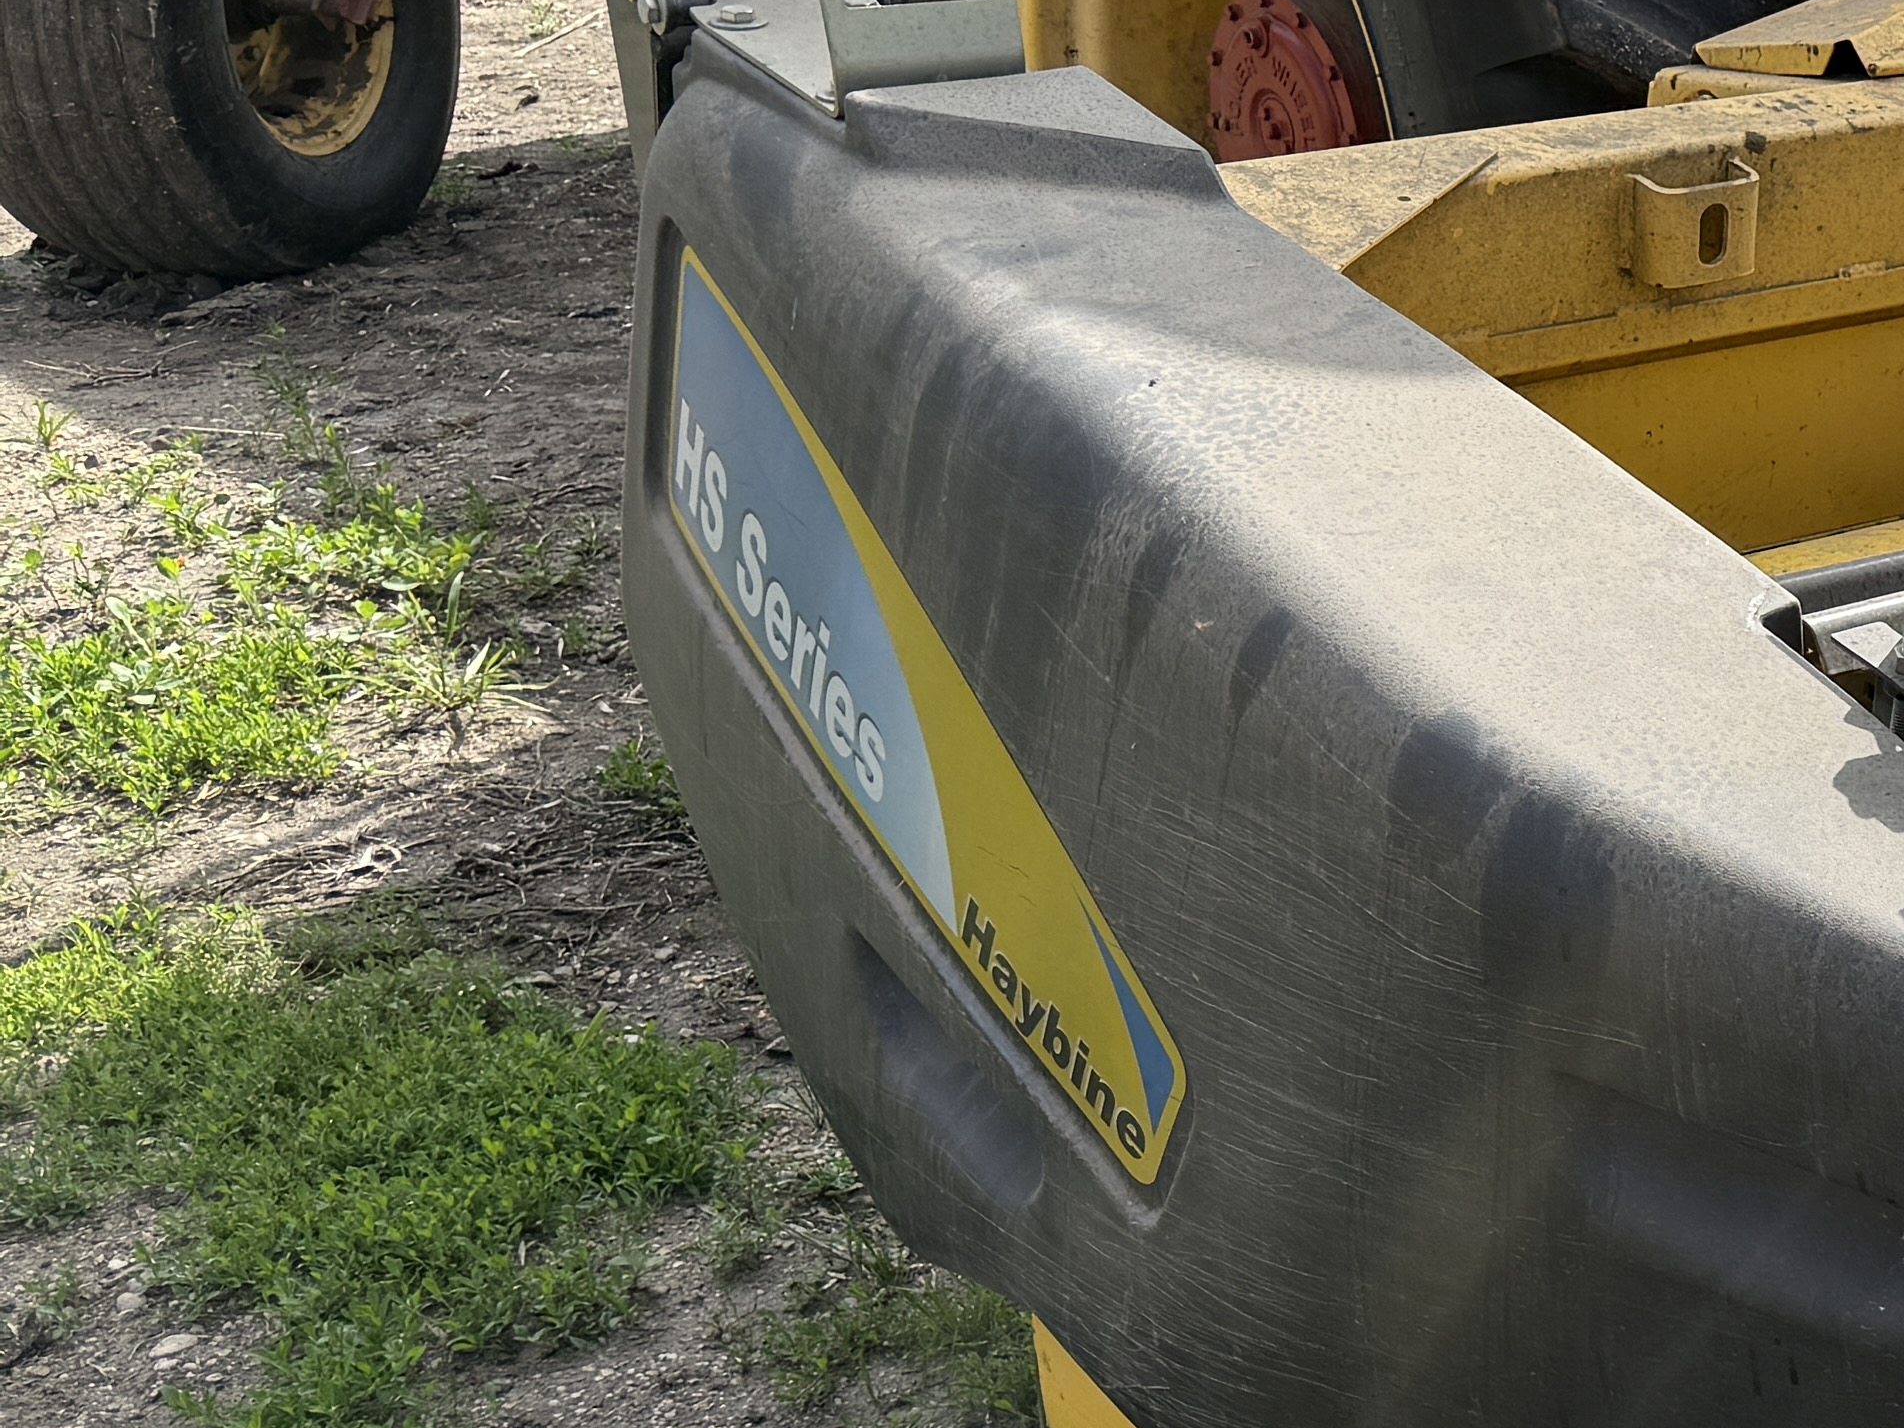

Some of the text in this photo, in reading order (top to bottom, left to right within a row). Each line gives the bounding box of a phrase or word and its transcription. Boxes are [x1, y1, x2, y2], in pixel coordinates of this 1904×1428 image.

[674, 397, 887, 803] HS Series
[961, 894, 1146, 1160] Haybine
